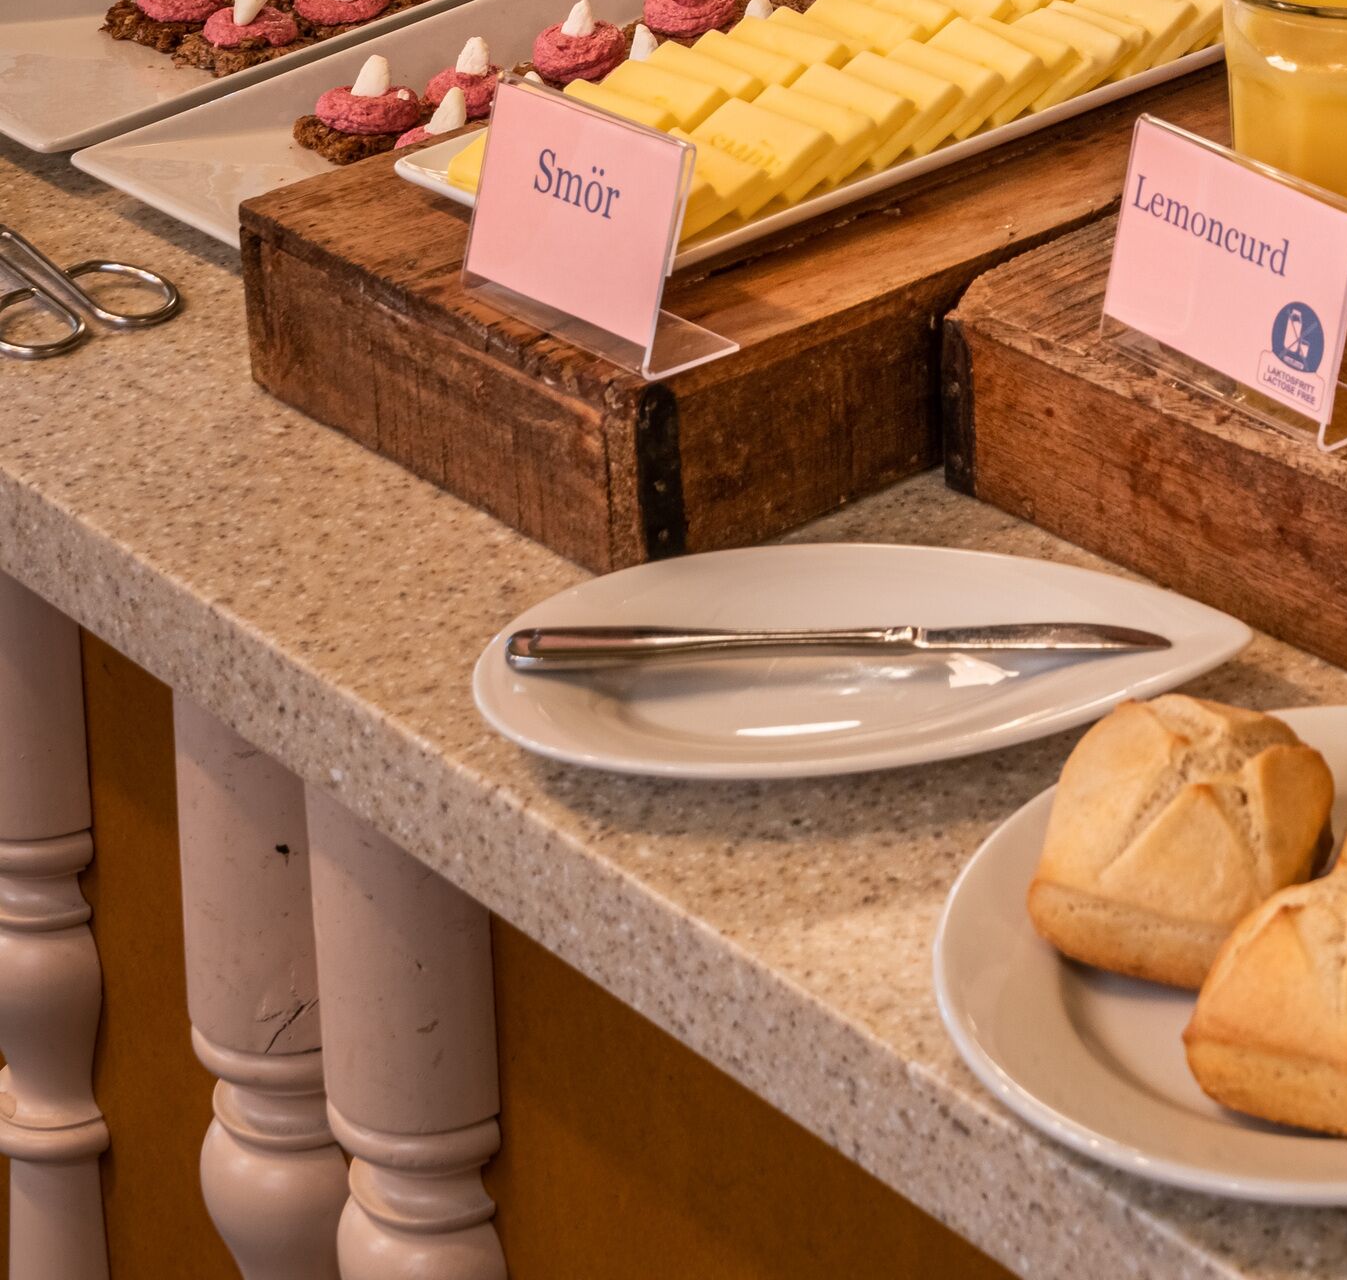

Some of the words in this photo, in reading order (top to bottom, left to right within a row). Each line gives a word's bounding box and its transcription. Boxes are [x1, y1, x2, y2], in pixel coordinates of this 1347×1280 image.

[533, 147, 621, 220] Smör
[1132, 174, 1290, 277] Lemoncurd
[1262, 372, 1295, 396] LACTOSE
[1296, 388, 1316, 405] FREE
